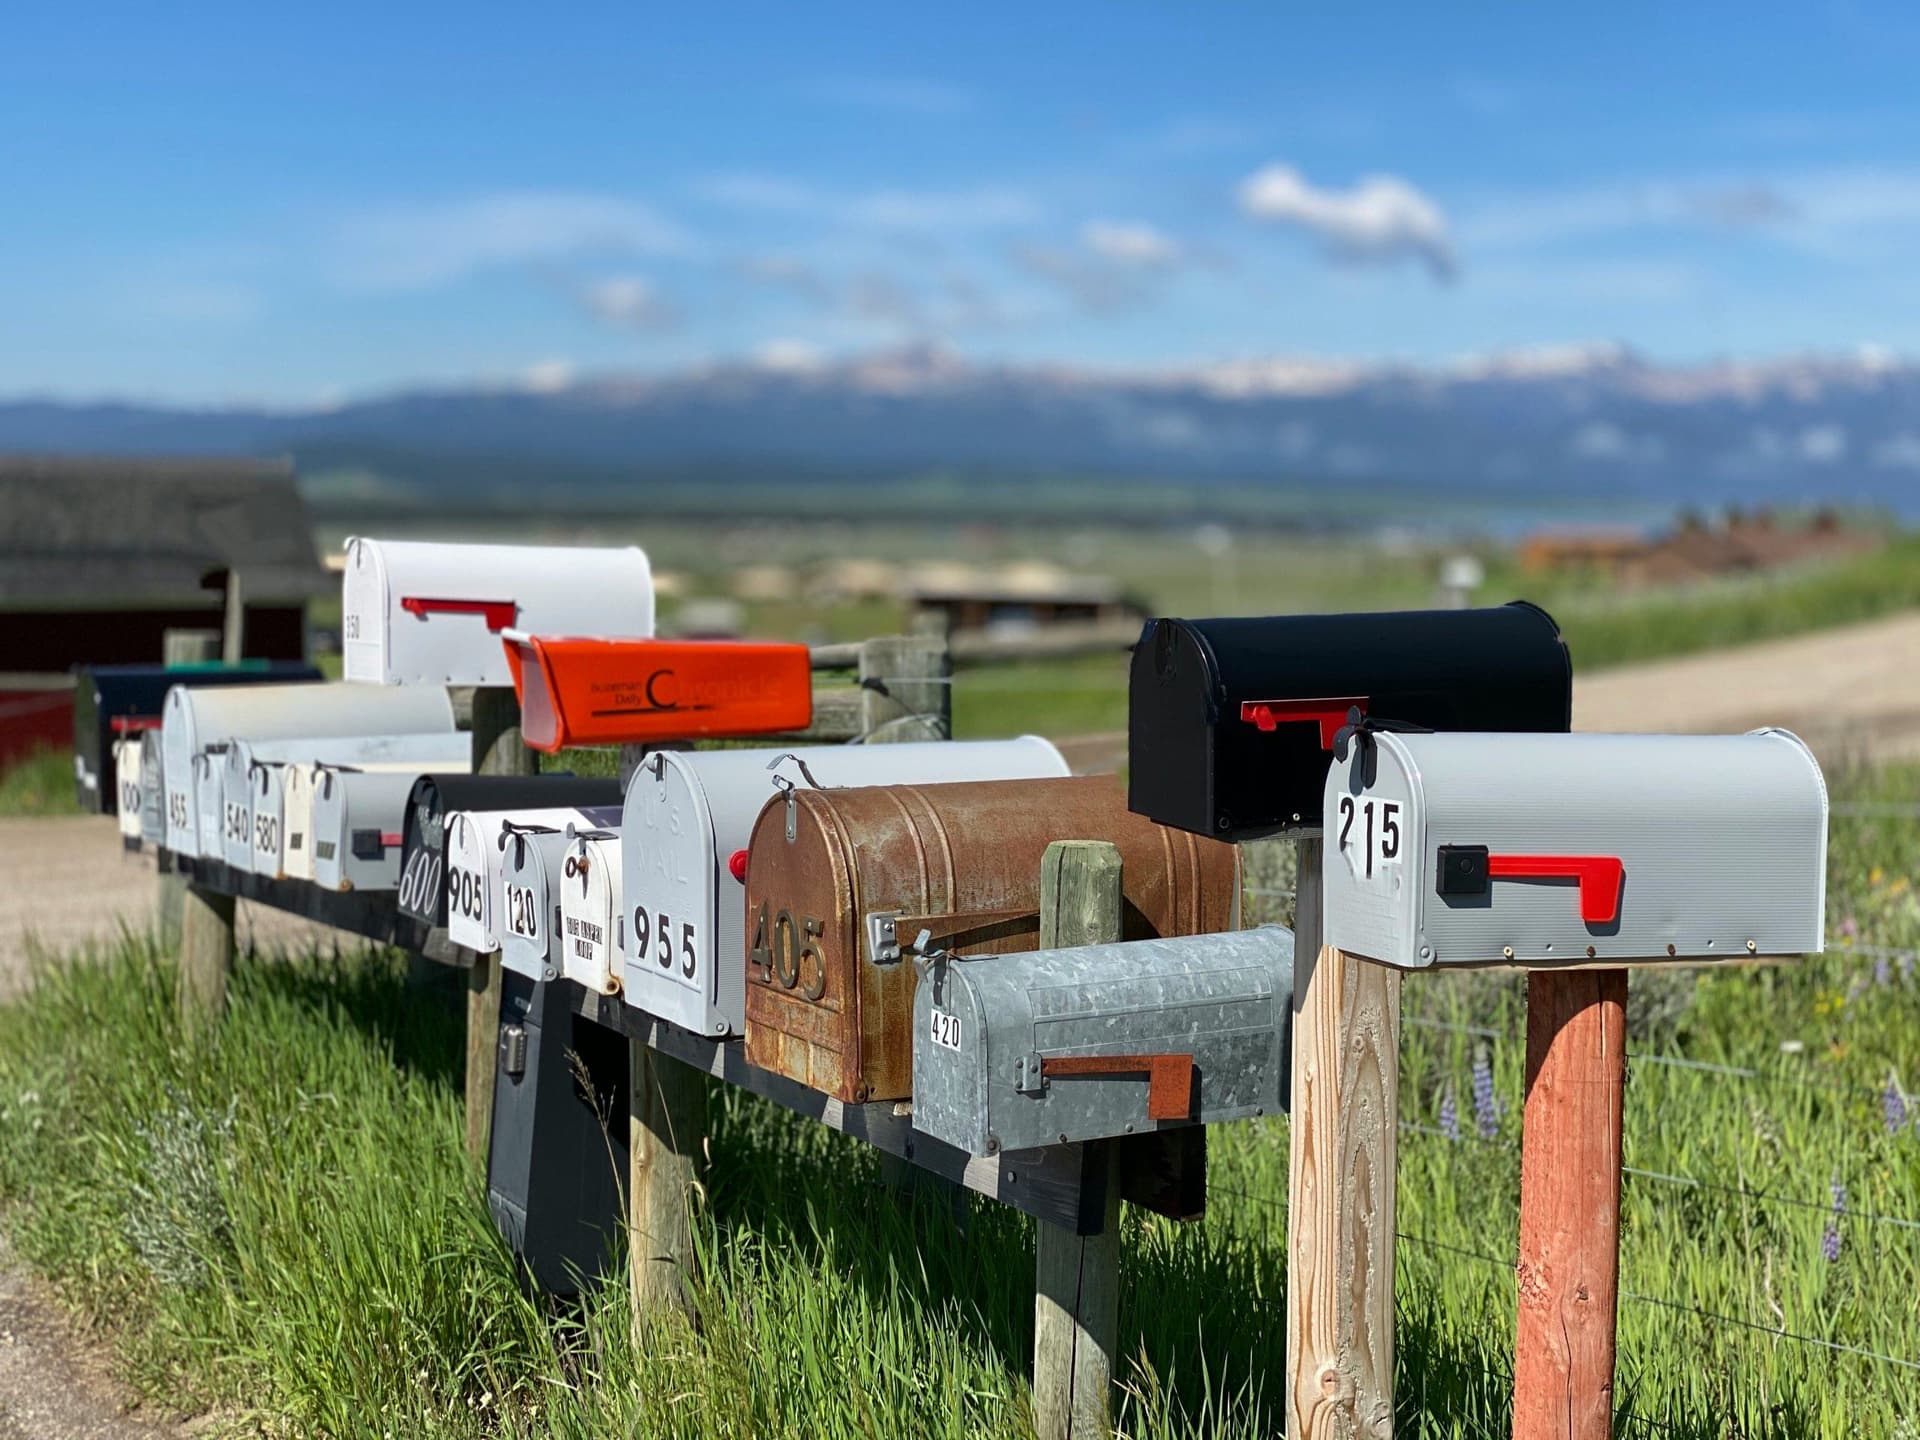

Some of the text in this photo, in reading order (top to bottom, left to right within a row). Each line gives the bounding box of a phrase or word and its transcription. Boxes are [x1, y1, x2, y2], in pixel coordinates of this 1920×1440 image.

[227, 803, 249, 844] 540
[256, 814, 278, 855] 580
[1339, 796, 1399, 880] 215
[399, 848, 442, 915] 600
[449, 866, 482, 921] 905
[506, 884, 536, 937] 120
[580, 919, 603, 945] ASPEN
[574, 938, 593, 961] LOOP
[634, 905, 696, 980] 955
[751, 901, 825, 1000] 405
[932, 1012, 960, 1048] 420
